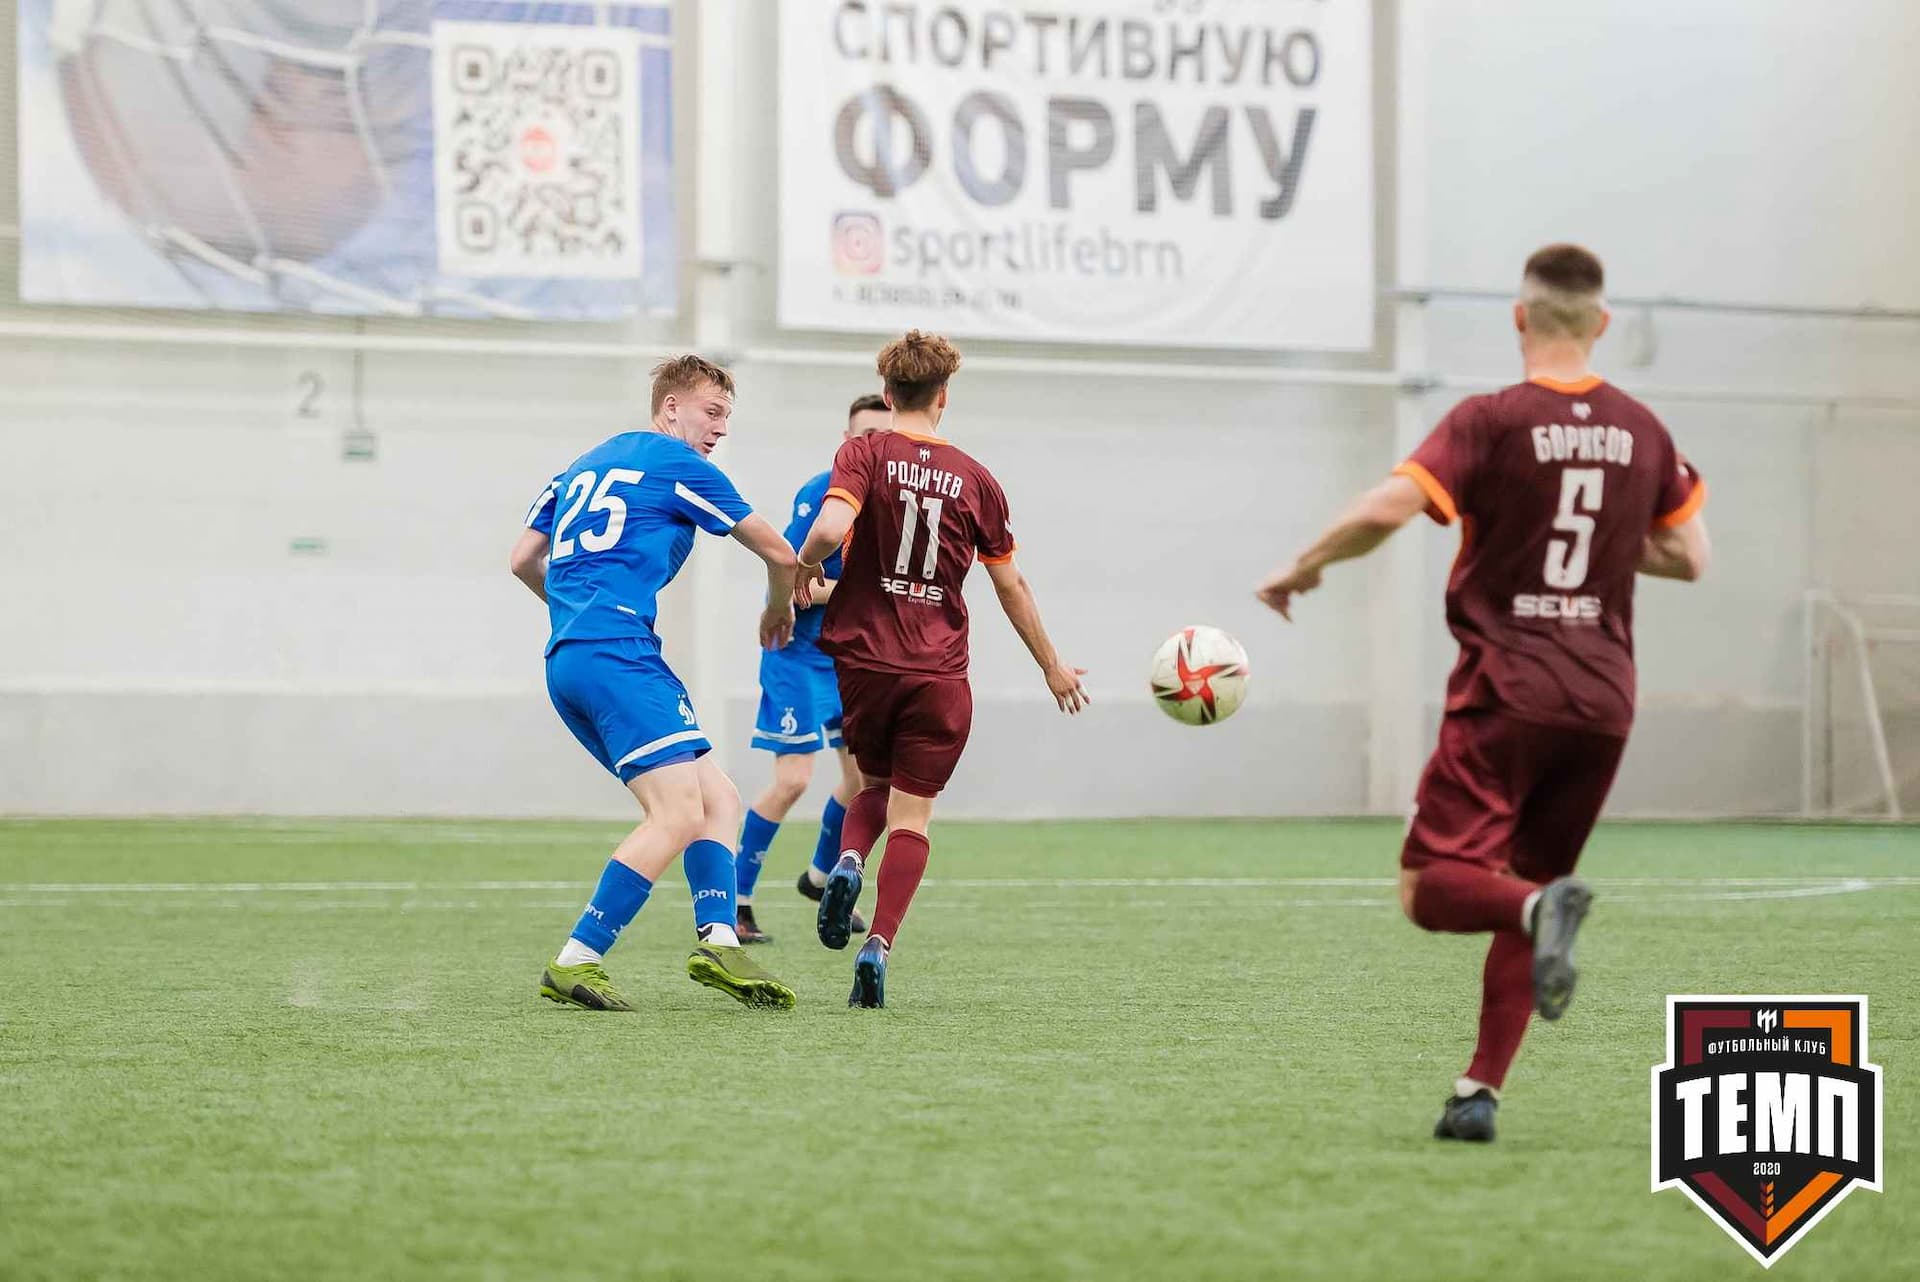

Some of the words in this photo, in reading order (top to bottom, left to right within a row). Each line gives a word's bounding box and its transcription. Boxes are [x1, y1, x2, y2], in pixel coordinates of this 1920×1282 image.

[832, 0, 1322, 88] СПОРТИВНУЮ
[833, 83, 1317, 220] ФОРМУ
[891, 221, 1185, 281] sportlifebrn
[296, 370, 325, 419] 2
[1531, 423, 1634, 466] БОРИСОВ
[887, 460, 963, 499] РОДИЧЕВ
[551, 467, 645, 560] 25
[894, 488, 944, 580] 11
[1542, 467, 1605, 590] 5
[880, 575, 944, 601] SEUS
[1512, 594, 1601, 618] SEUS
